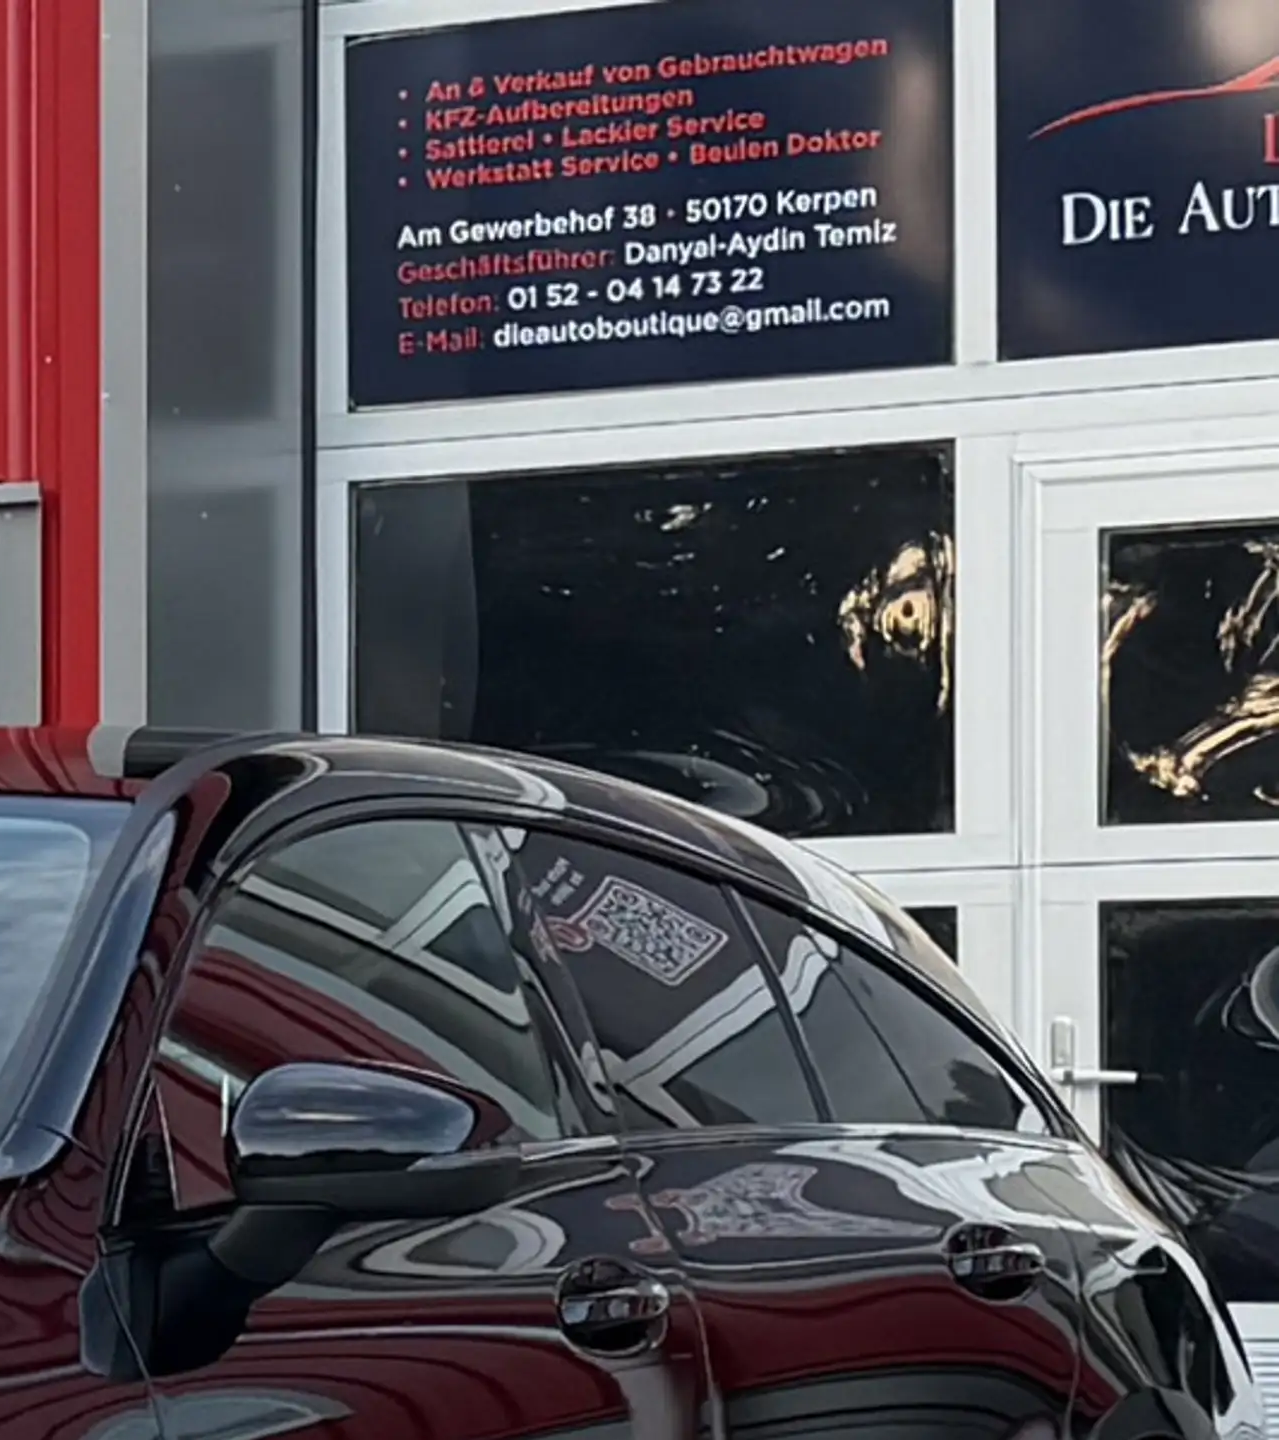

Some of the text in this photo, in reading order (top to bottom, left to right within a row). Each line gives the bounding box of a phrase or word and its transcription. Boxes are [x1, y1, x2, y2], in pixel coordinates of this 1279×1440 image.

[425, 38, 889, 102] An & Verkauf von Gebrauchtwagen
[425, 88, 694, 130] KFZ-Aufbereitungen
[425, 109, 766, 162] Sattlerei Lackier Service
[427, 128, 881, 190] Werkstatt Service Beulen Doktor
[398, 186, 878, 250] Am Gewerbehof 38 50170 Kerpen
[398, 218, 897, 284] Geschäftsführer: Danyal-Aydin Temiz
[399, 294, 499, 319] Telefon:
[508, 286, 537, 311] 01
[545, 284, 578, 308] 52
[607, 278, 644, 303] 04
[652, 275, 680, 299] 14
[692, 272, 722, 295] 73
[731, 268, 763, 292] 22
[399, 297, 890, 355] E-Mail: dieautoboutique@gmail.com
